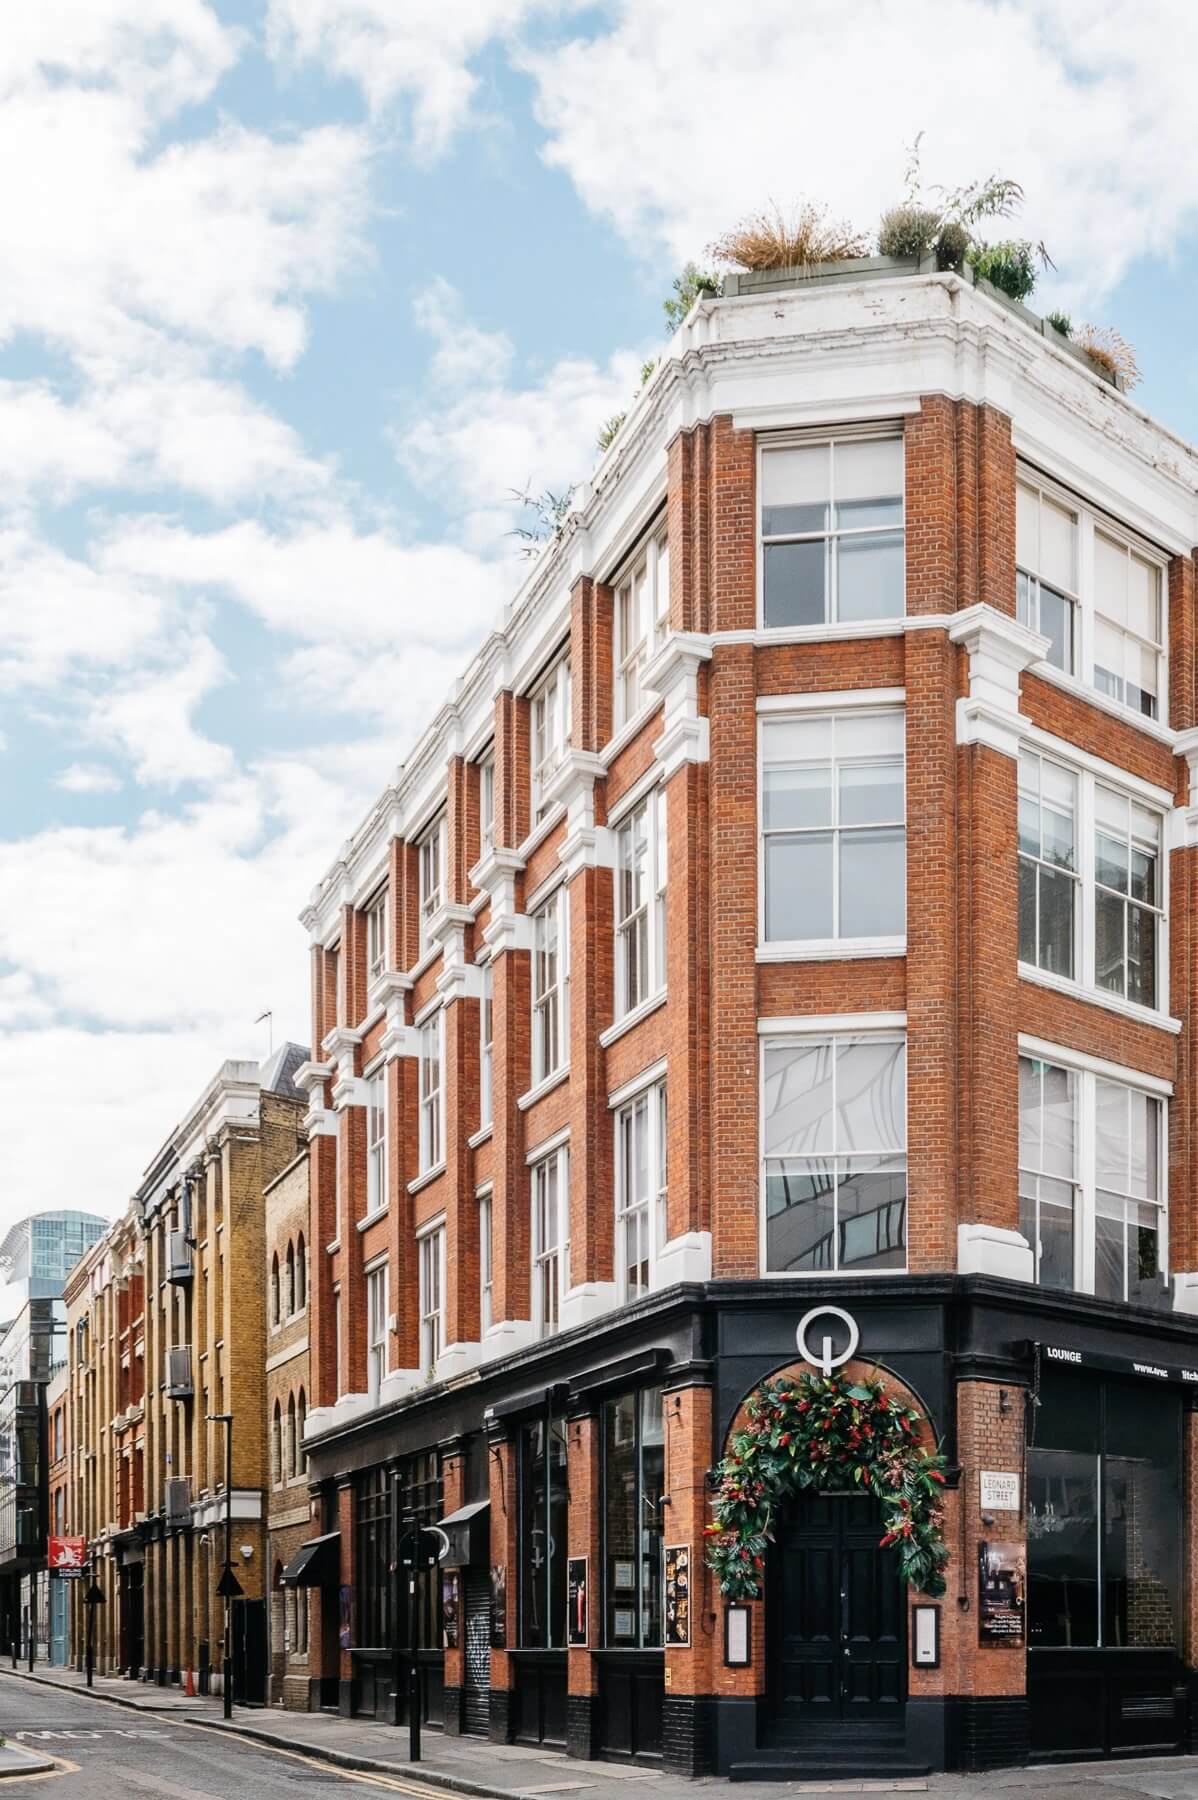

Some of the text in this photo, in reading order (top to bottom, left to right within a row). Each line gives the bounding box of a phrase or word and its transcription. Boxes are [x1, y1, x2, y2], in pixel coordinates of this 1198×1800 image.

[796, 1305, 859, 1376] Q
[1047, 1347, 1082, 1363] LOUNGE
[984, 1479, 1016, 1490] LEONARD
[987, 1490, 1014, 1501] STREET
